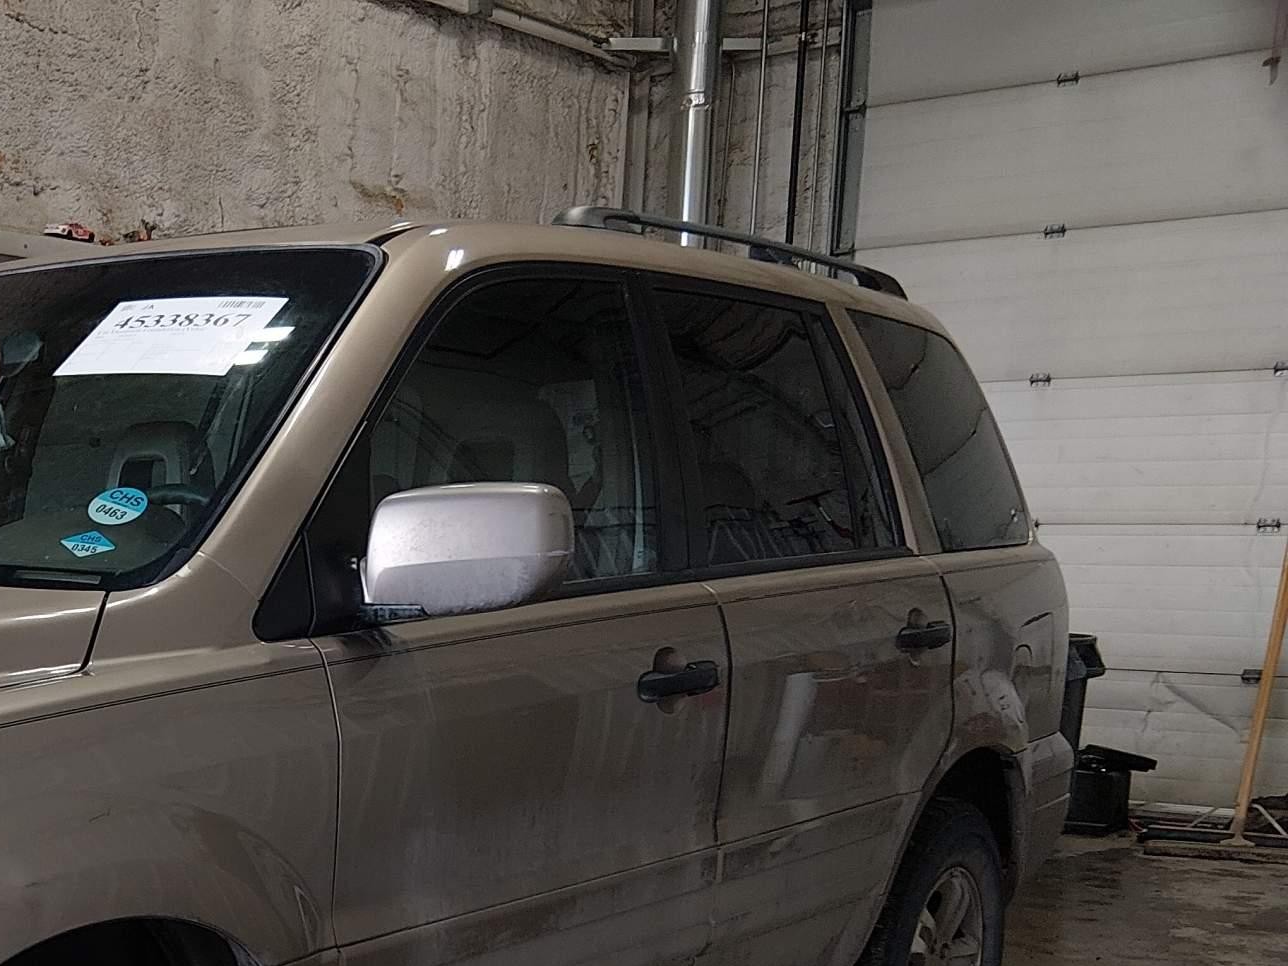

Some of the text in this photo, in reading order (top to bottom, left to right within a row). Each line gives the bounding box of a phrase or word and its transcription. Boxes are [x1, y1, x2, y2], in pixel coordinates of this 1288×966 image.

[114, 313, 252, 329] 45338367
[109, 489, 145, 507] CHS
[95, 504, 128, 521] 0463
[79, 534, 102, 543] CHS
[71, 543, 98, 554] 0345
